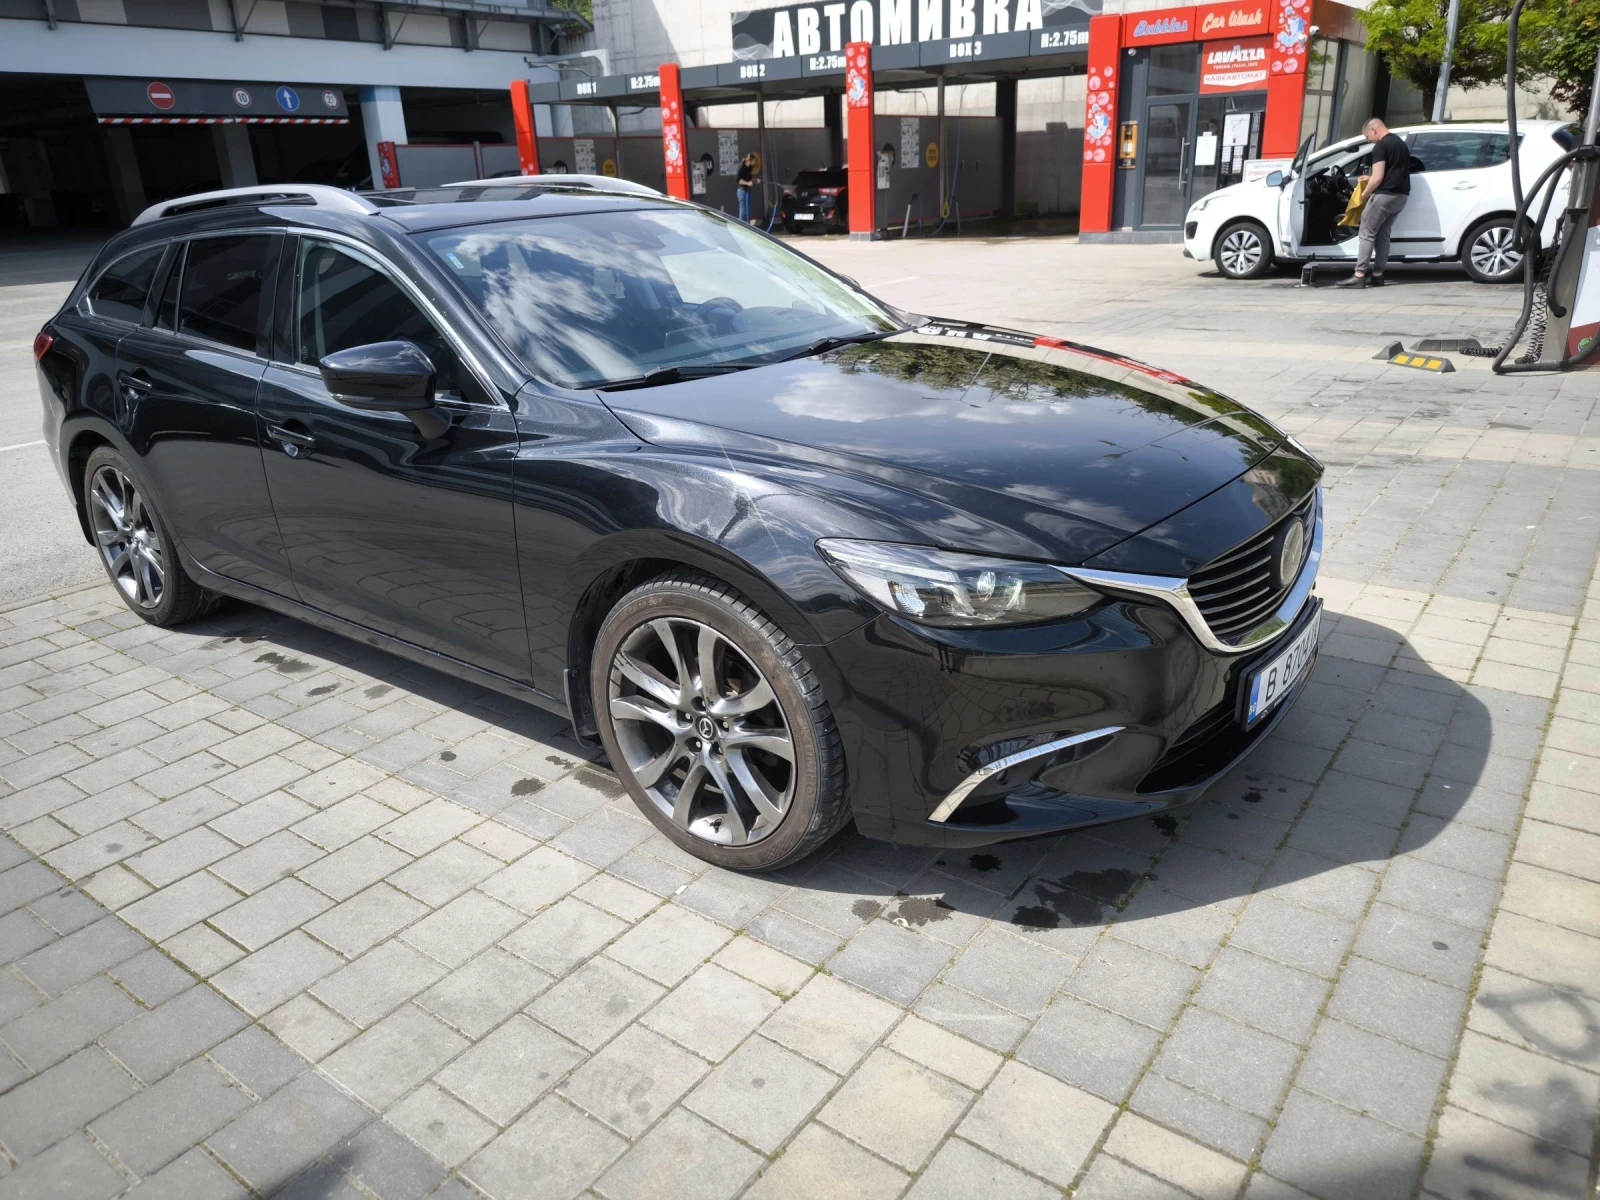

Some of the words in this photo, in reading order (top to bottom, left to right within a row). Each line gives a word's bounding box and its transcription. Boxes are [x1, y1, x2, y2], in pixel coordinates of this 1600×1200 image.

[773, 0, 1043, 58] АВТОМИВКА
[1133, 17, 1188, 37] Bubbles
[1202, 12, 1225, 33] Car
[1228, 8, 1263, 27] Wash
[1041, 30, 1089, 48] H:2.75m
[950, 42, 972, 58] BOX
[974, 41, 982, 56] 3
[1207, 44, 1265, 64] LAVAZZA
[740, 65, 758, 79] BOX
[759, 64, 766, 77] 2
[592, 82, 597, 94] 1
[237, 93, 248, 103] 10
[1265, 666, 1278, 702] B
